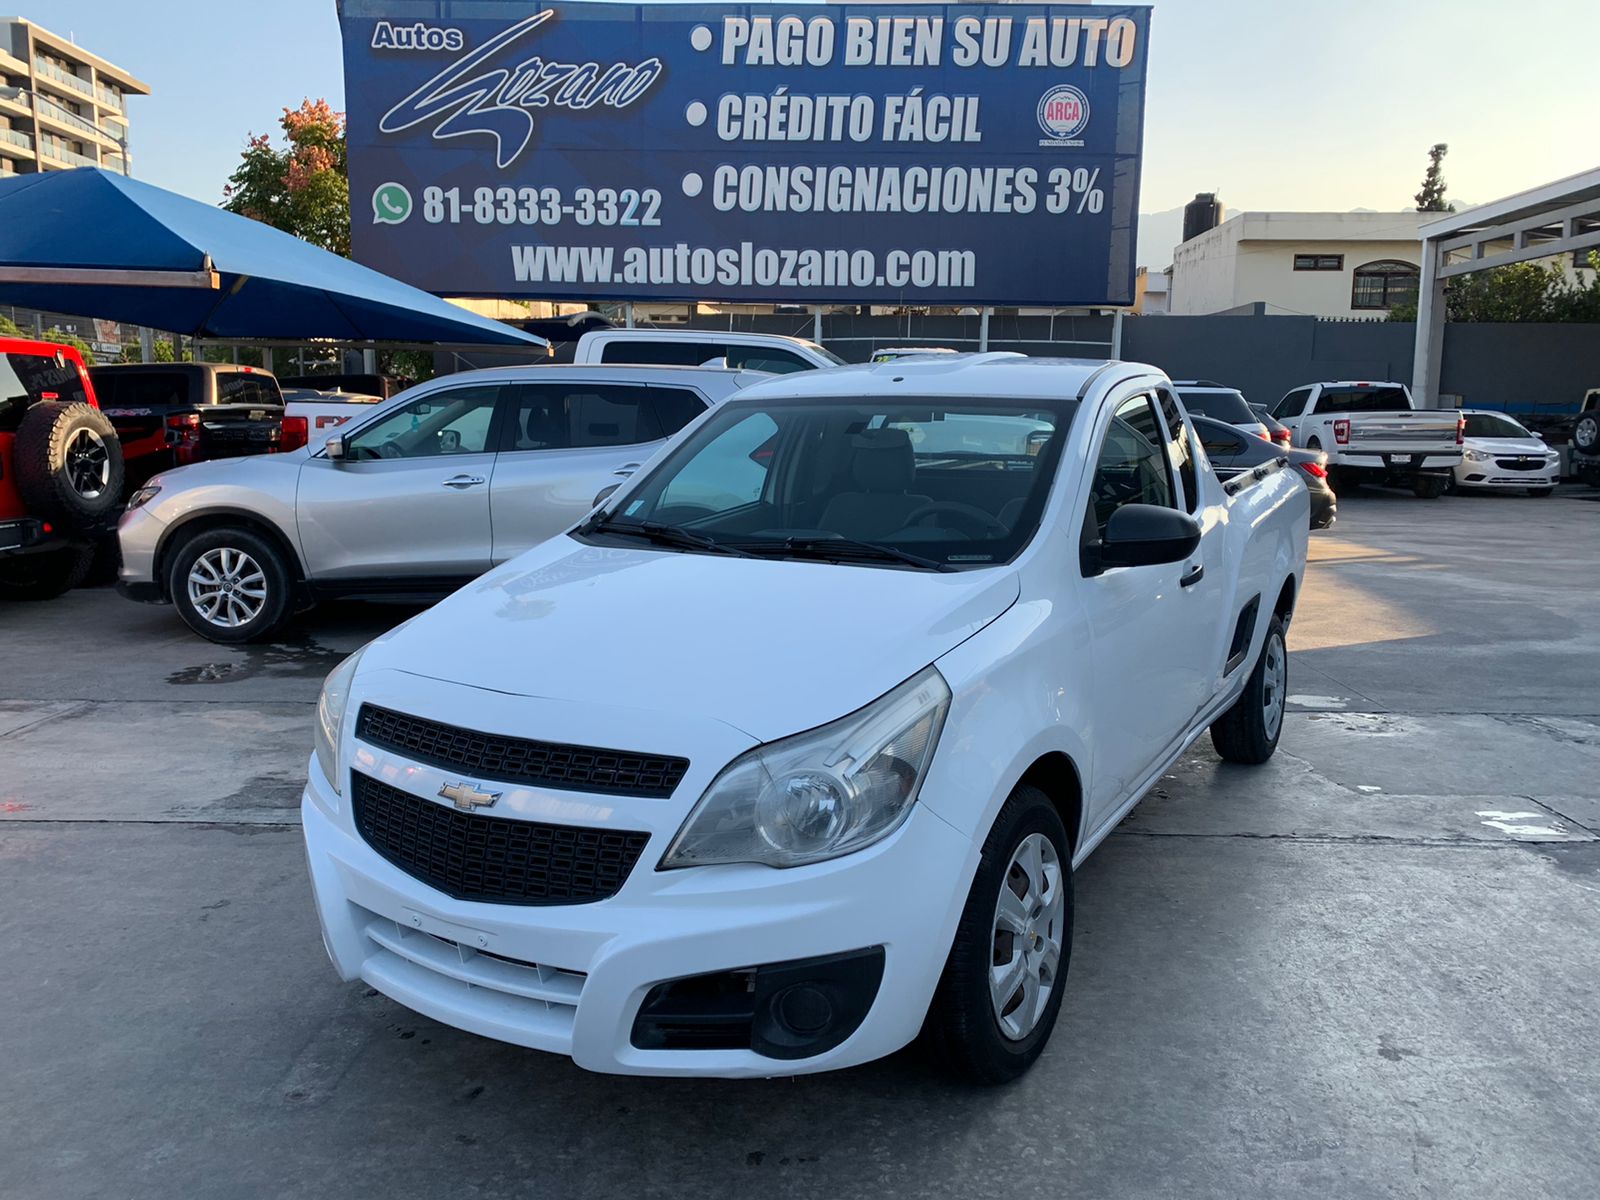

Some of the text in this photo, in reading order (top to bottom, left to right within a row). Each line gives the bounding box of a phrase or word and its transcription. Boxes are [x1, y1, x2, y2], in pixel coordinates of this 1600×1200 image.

[371, 21, 464, 51] Autos
[721, 16, 1137, 68] PAGO BIEN SU AUTO
[379, 9, 663, 168] Lozano
[1046, 101, 1080, 121] ARCA
[717, 86, 982, 143] CRÉDITO FÁCIL
[423, 186, 662, 227] 81-8333-3322
[712, 164, 1105, 215] CONSIGNACIONES 3%
[511, 242, 976, 288] www.autoslozano.com
